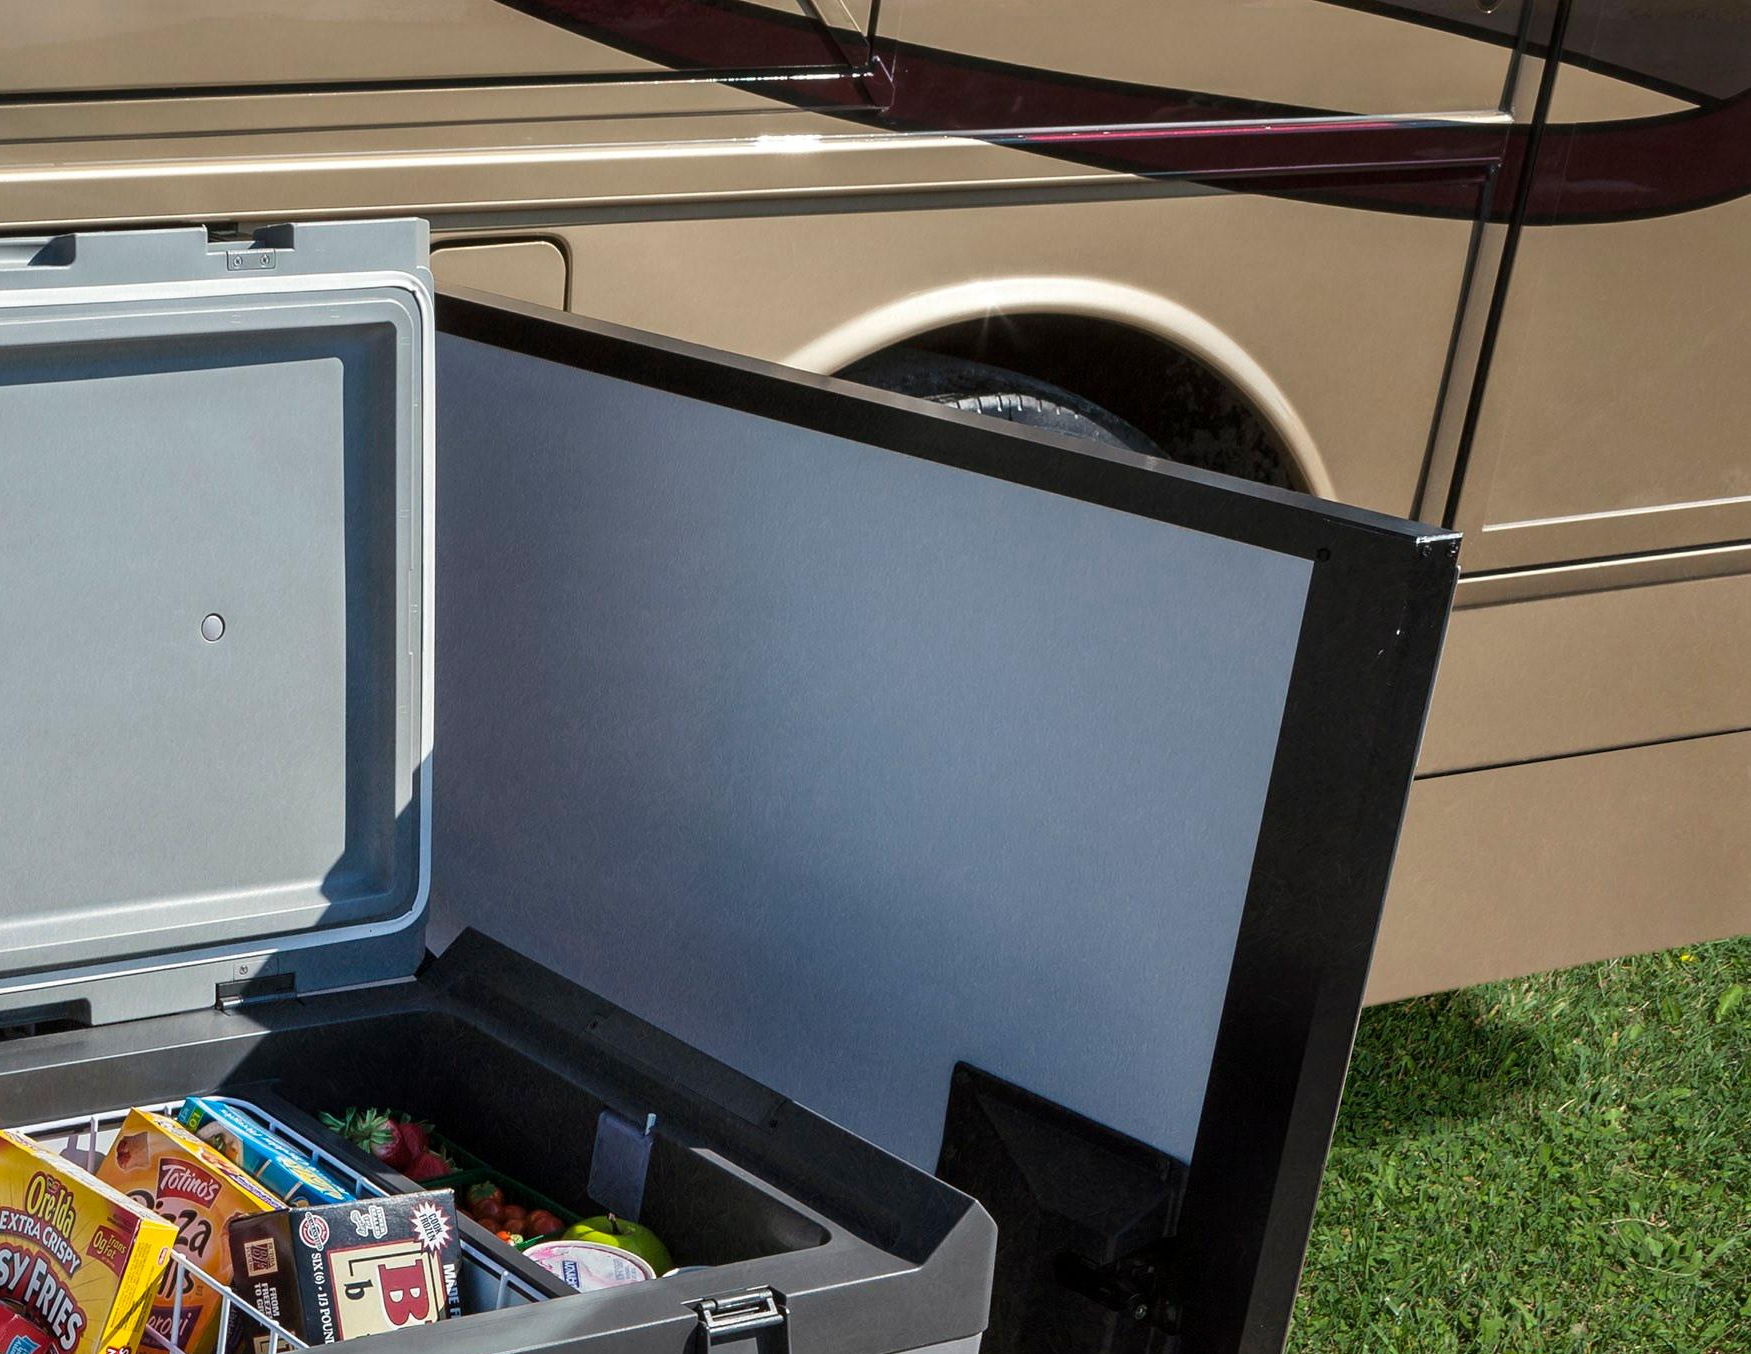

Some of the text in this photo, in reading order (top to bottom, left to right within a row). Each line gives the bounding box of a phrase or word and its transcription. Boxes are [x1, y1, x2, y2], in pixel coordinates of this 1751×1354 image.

[160, 1165, 220, 1201] Totino's
[419, 1213, 436, 1242] FROZEN
[428, 1213, 444, 1235] COOK
[42, 1227, 81, 1274] CRISPY
[311, 1252, 324, 1271] SIX
[254, 1283, 262, 1297] TO
[313, 1271, 326, 1288] (6)
[443, 1263, 460, 1304] MADE
[24, 1258, 83, 1347] FRIES
[261, 1282, 274, 1321] FREEZE
[269, 1287, 280, 1317] FROM
[317, 1293, 329, 1307] 1/3
